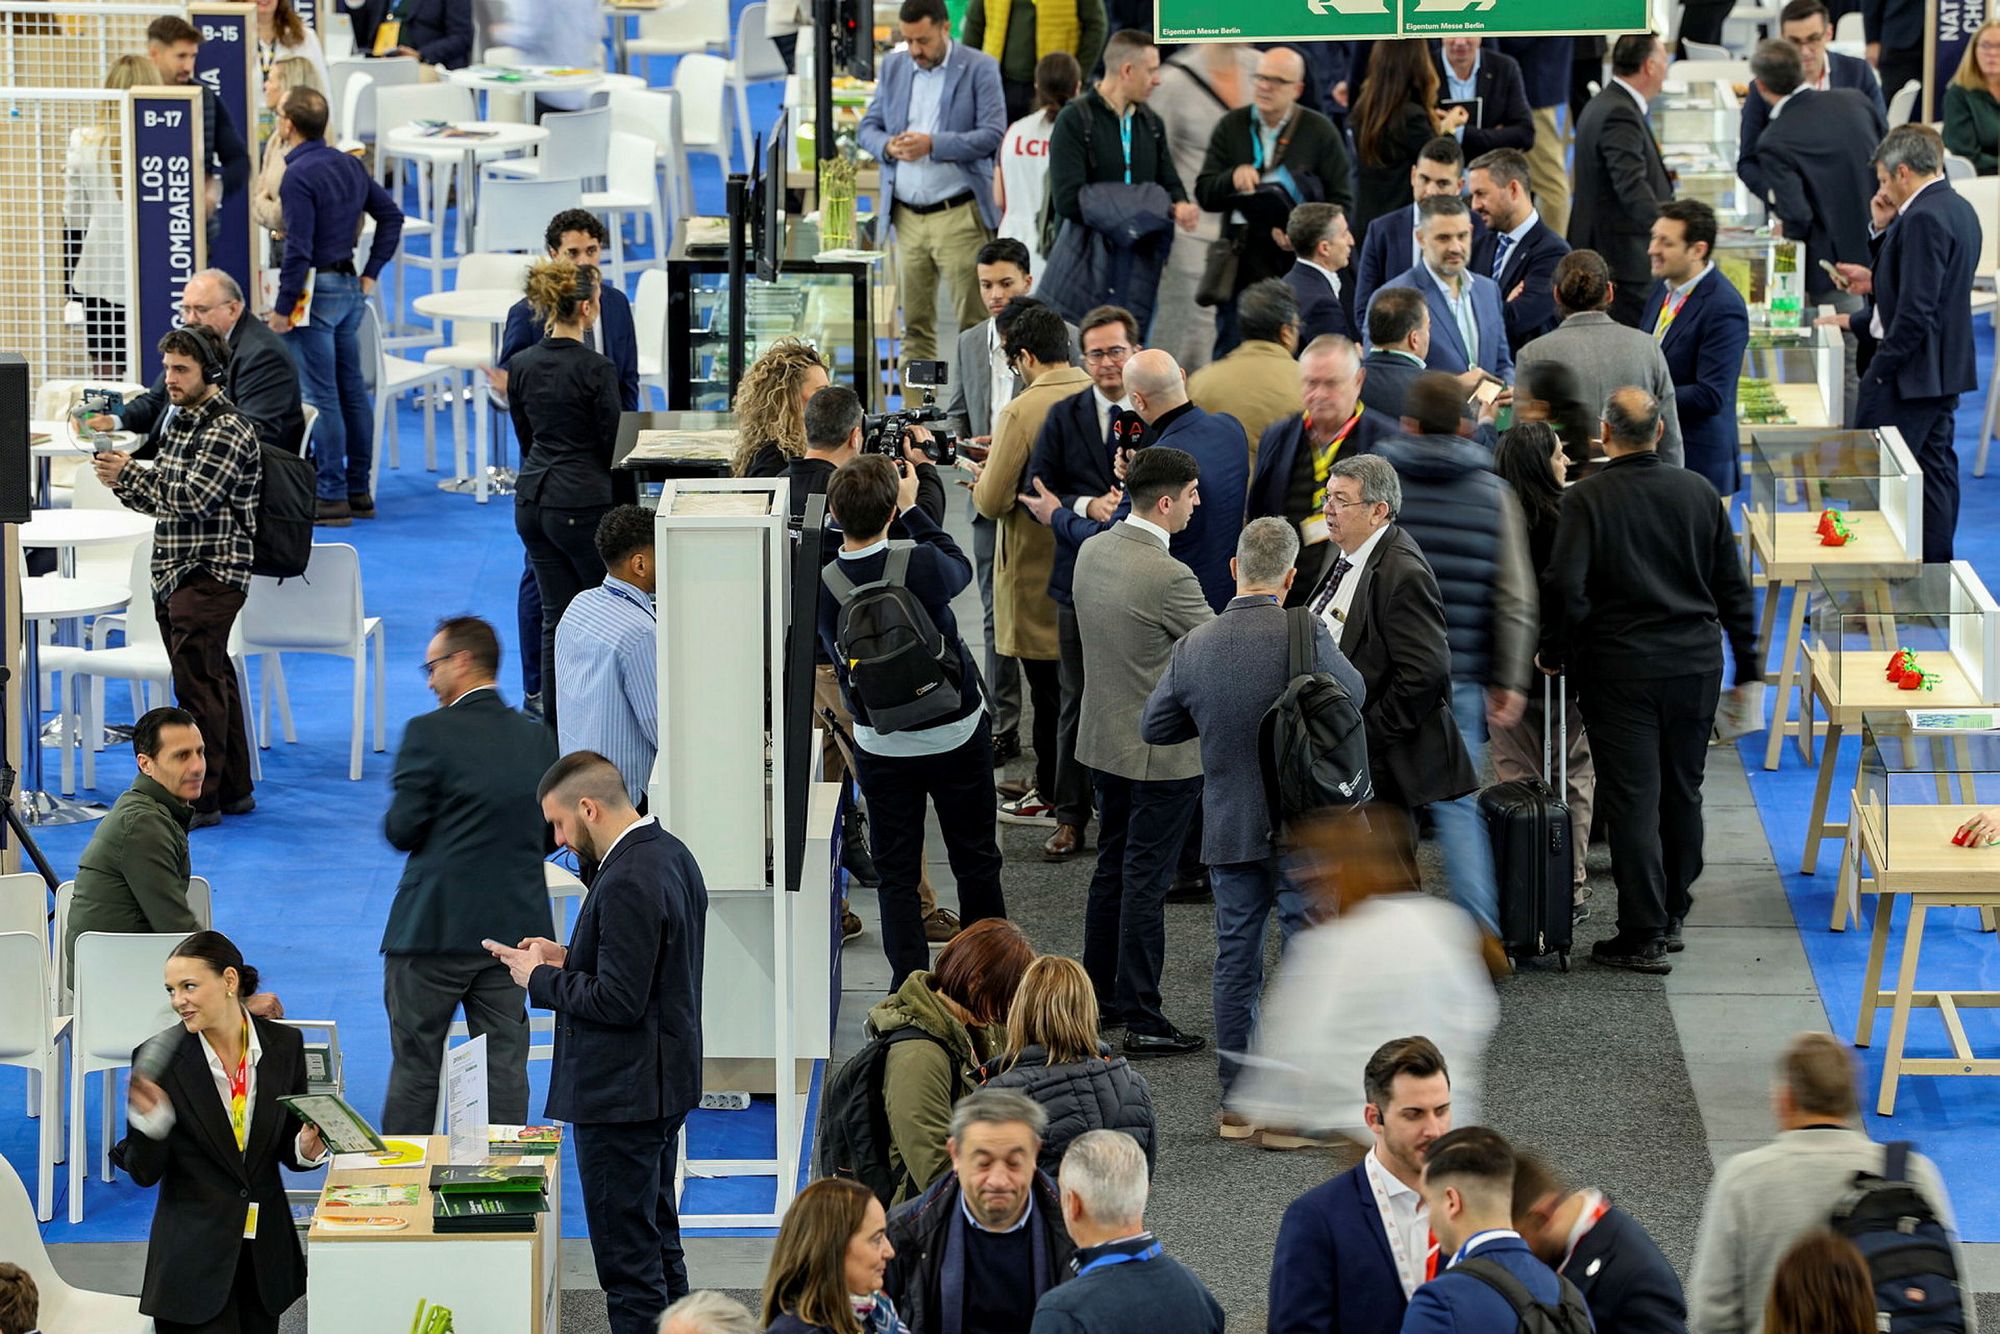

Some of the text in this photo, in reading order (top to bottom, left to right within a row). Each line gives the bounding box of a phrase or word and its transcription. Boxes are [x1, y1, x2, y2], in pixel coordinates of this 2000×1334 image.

[1962, 0, 1983, 34] CH
[201, 24, 239, 42] B-15
[1162, 28, 1196, 36] Eigentum
[1196, 27, 1219, 35] Messe
[1406, 23, 1439, 31] Eigentum
[1440, 22, 1463, 30] Messe
[144, 110, 183, 128] B-17
[141, 155, 164, 202] LOS
